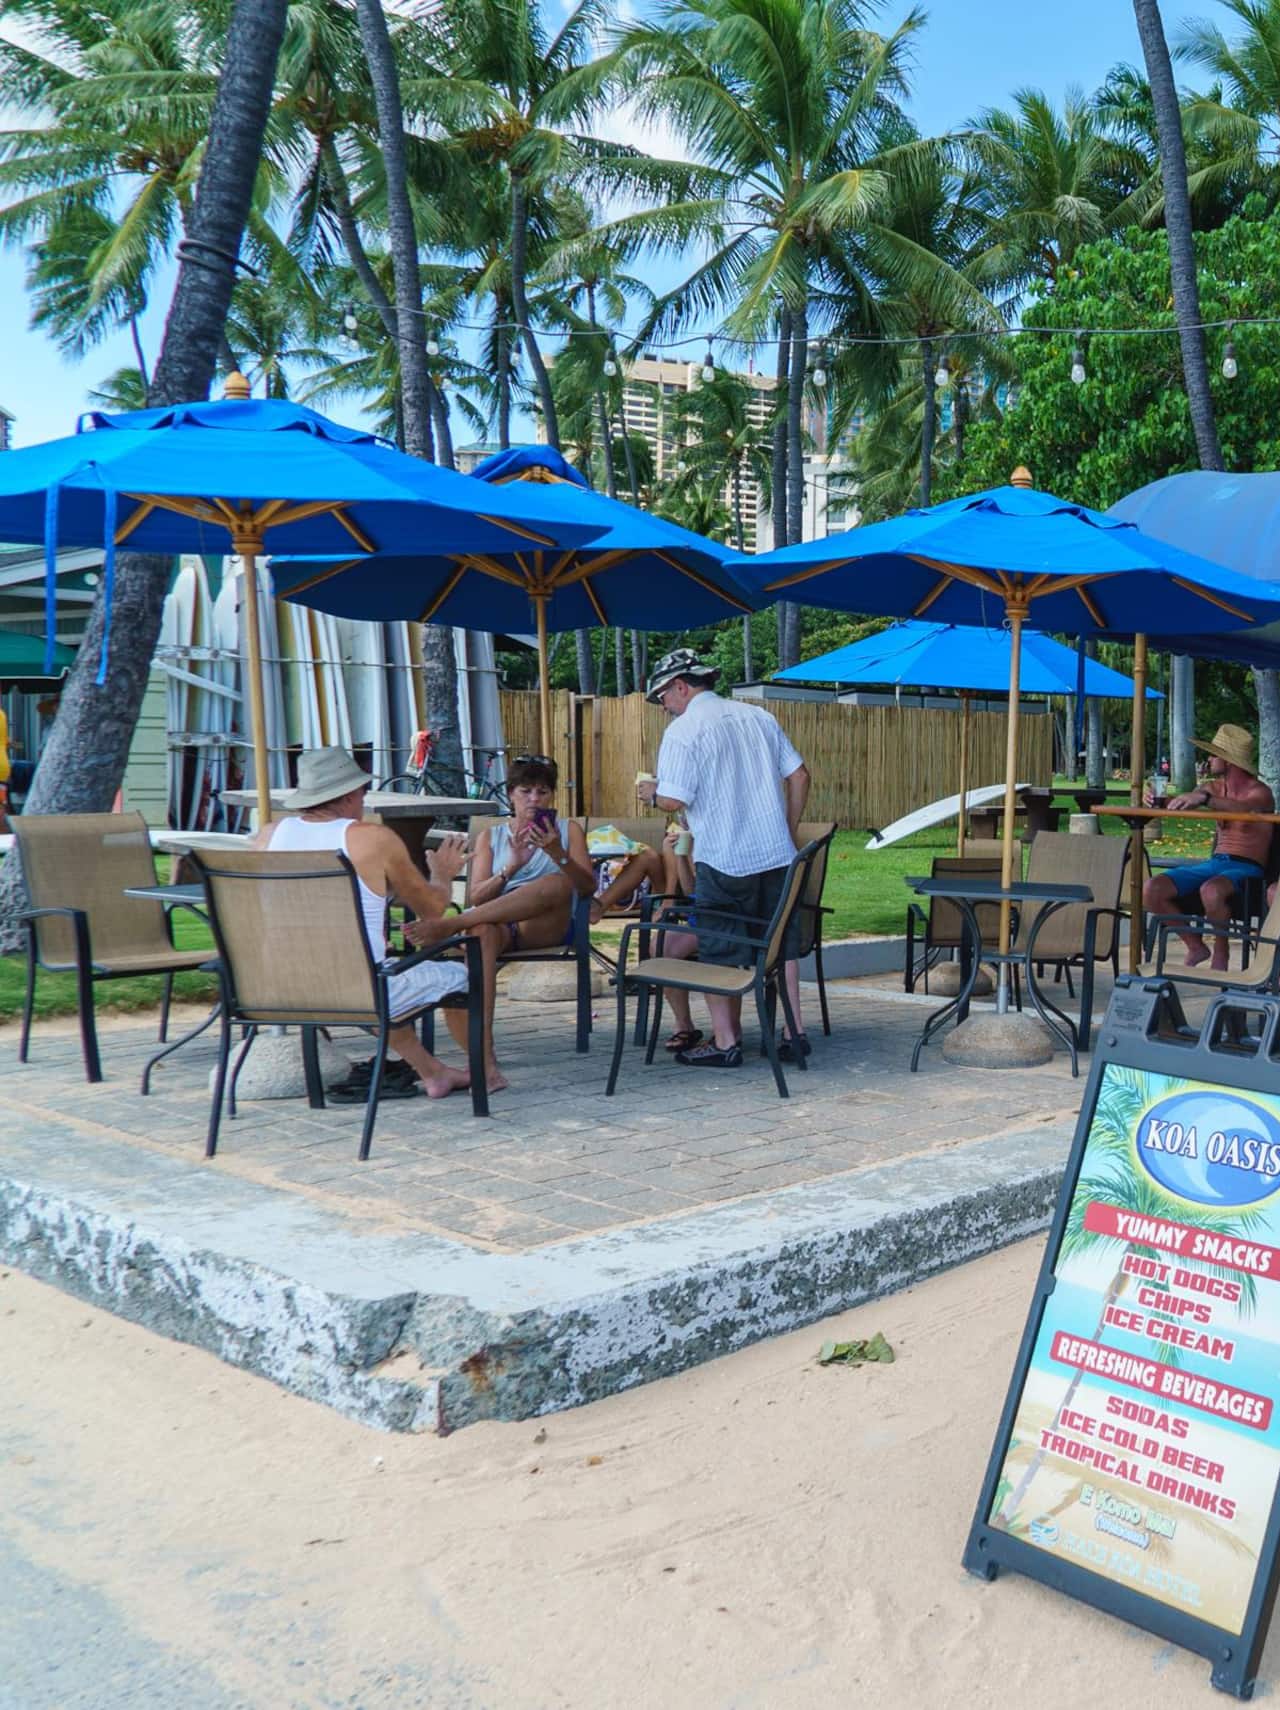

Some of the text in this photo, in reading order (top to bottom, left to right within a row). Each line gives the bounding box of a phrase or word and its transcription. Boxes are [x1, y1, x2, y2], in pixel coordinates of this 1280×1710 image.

[1144, 1119, 1198, 1159] KOA
[1116, 1213, 1273, 1272] YUMMY SNACKS
[1123, 1255, 1241, 1302] HOT DOGS
[1138, 1288, 1212, 1324] CHIPS
[1105, 1306, 1234, 1361] ICE CREAM
[1057, 1337, 1265, 1424] REFRESHING BEVERAGES
[1106, 1395, 1190, 1439] SODAS
[1059, 1408, 1225, 1484] ICE COLD BEER
[1040, 1429, 1237, 1520] TROPICAL DRINKS
[1080, 1483, 1094, 1506] E
